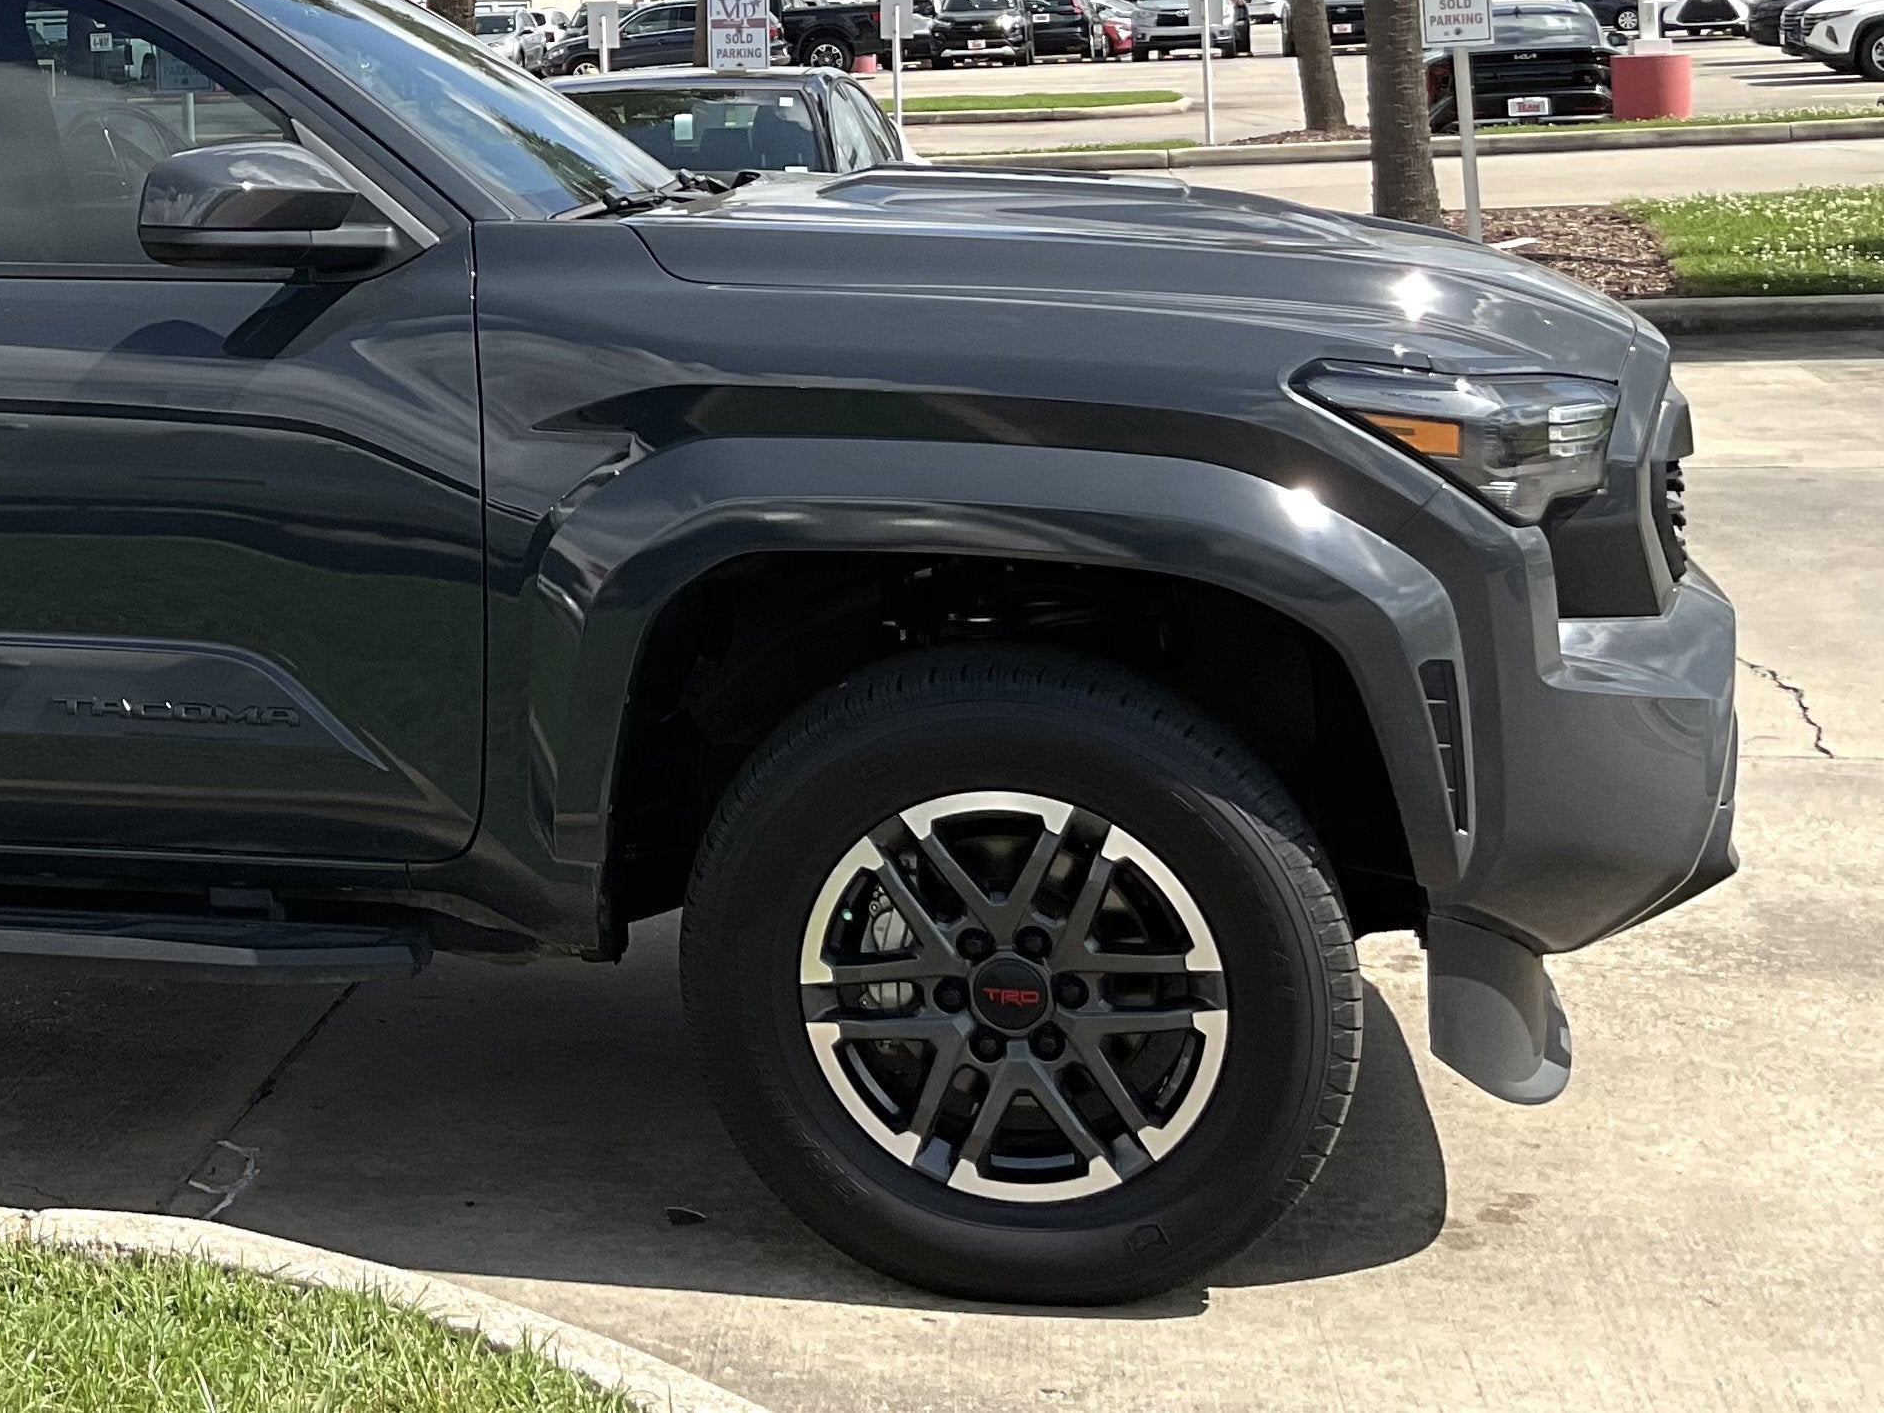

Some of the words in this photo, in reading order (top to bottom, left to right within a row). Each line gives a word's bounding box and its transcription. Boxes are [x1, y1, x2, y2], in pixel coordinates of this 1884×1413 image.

[1429, 13, 1483, 26] PARKING
[724, 33, 753, 44] SOLD
[716, 47, 762, 59] PARKING
[50, 694, 301, 728] TACOMA
[982, 987, 1040, 1006] TRD
